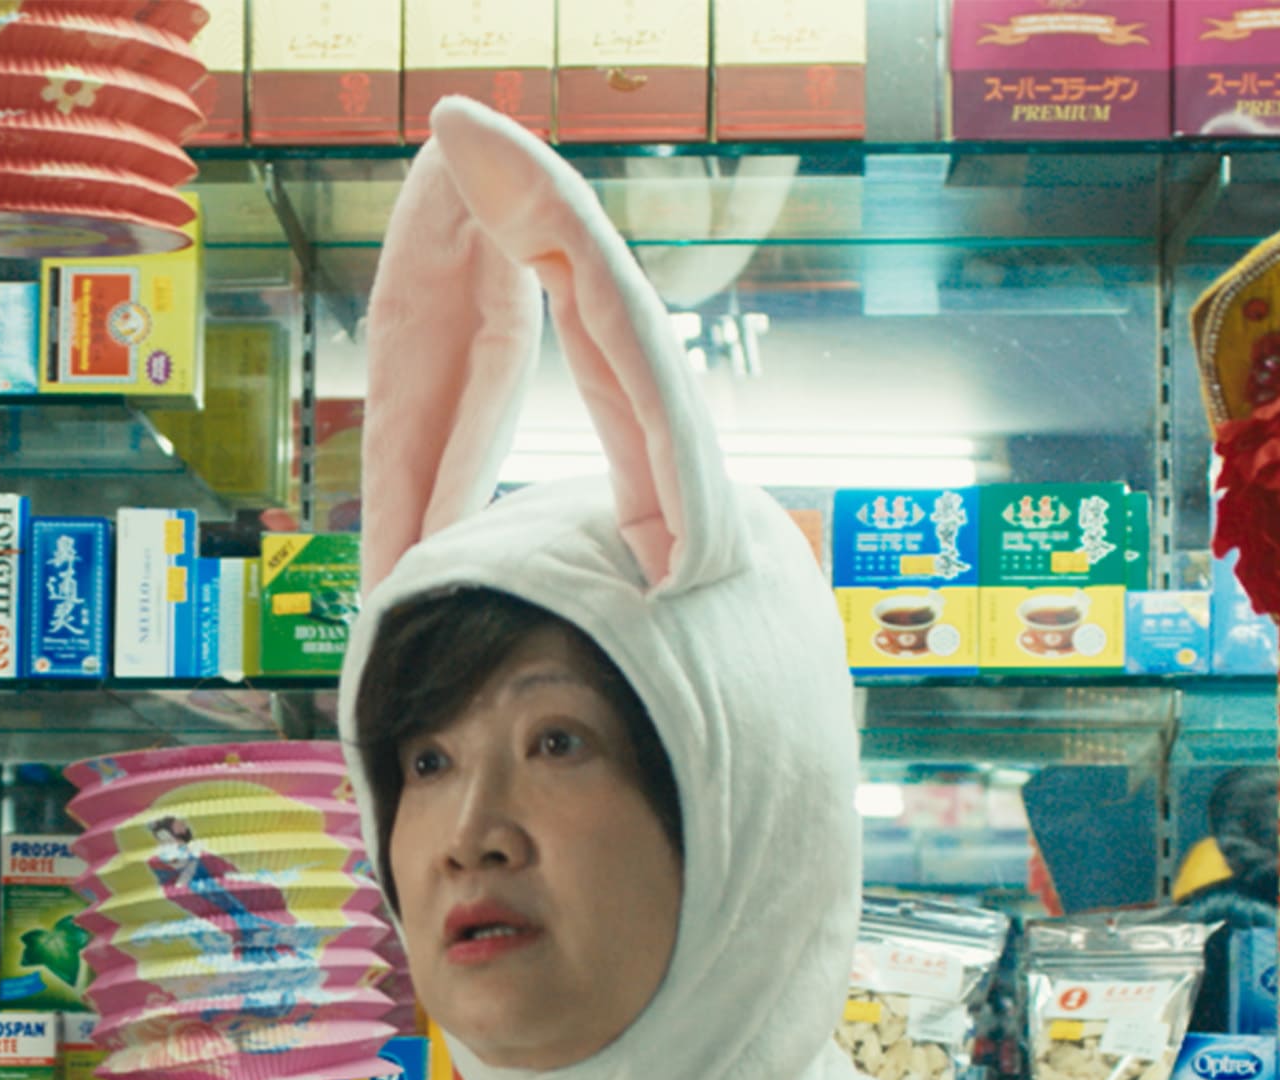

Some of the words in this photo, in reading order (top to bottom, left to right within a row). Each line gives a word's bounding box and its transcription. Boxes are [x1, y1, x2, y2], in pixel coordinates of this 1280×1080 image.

[984, 77, 1138, 100] スーパーコラーゲン
[1012, 104, 1111, 121] PREMIUM
[11, 841, 76, 858] PROSPA
[11, 858, 56, 874] FORTE
[1195, 1054, 1257, 1079] Optrex
